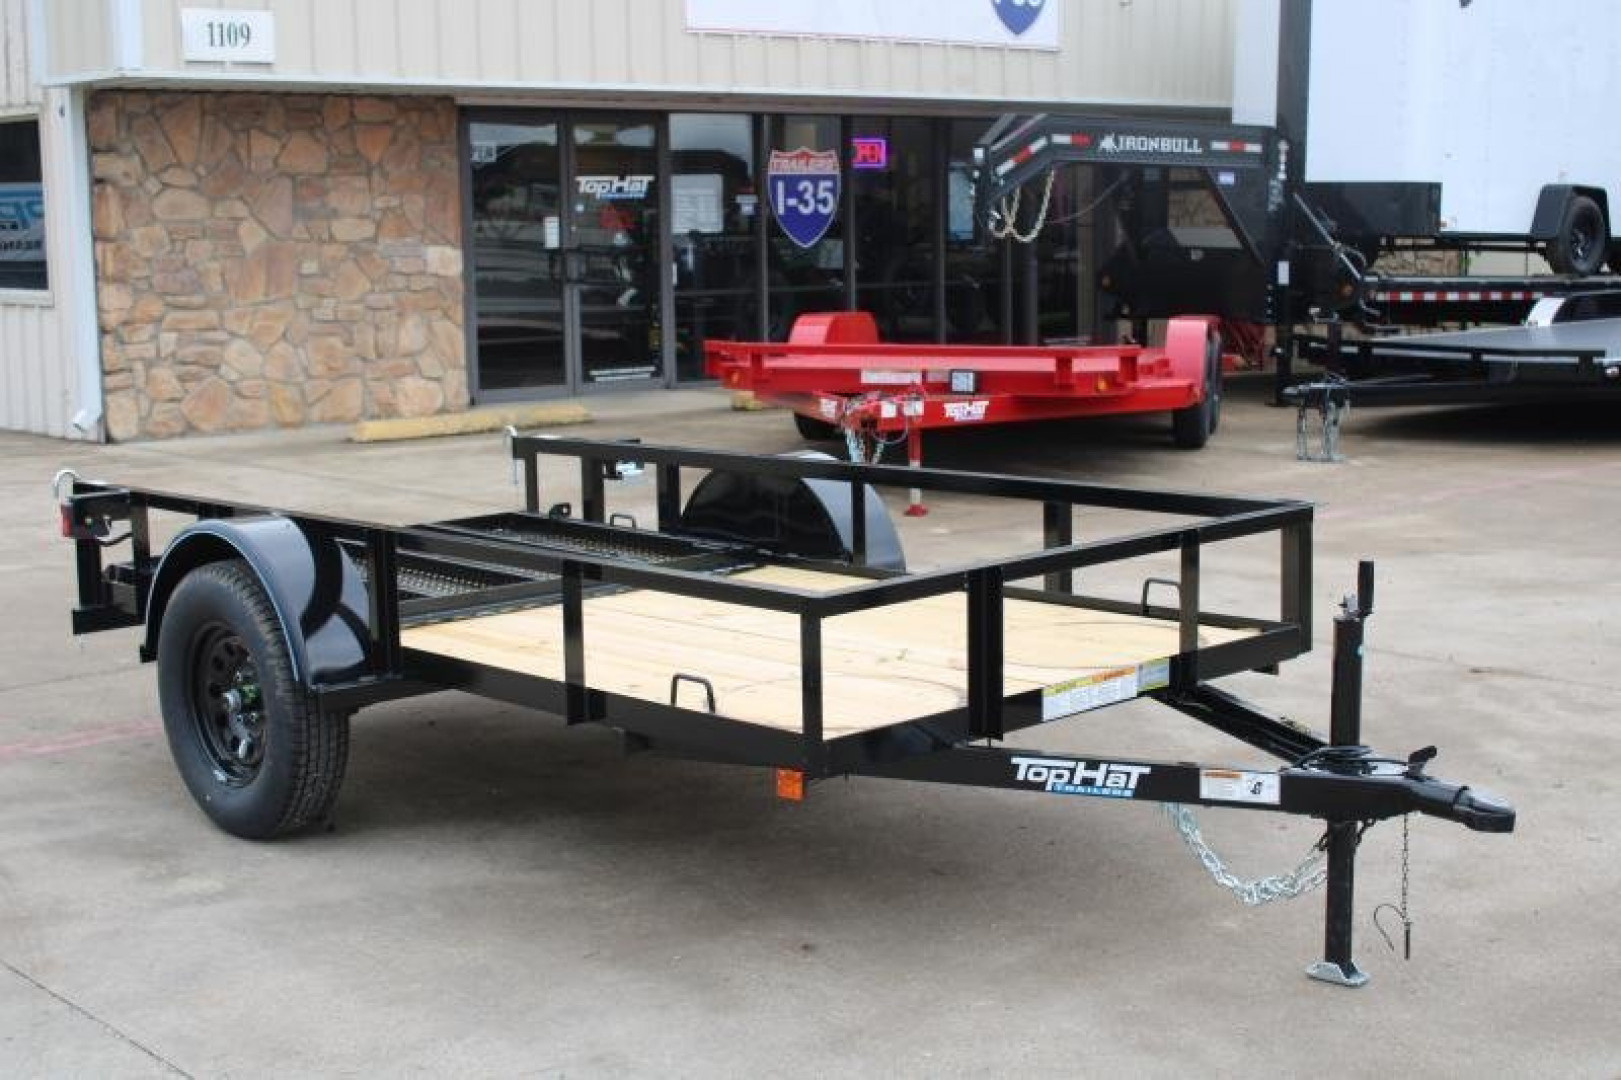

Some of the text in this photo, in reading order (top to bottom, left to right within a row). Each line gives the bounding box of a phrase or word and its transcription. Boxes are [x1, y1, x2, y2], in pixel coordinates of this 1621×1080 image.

[207, 21, 250, 48] 1109
[1117, 134, 1203, 153] IRONBULL
[777, 180, 834, 215] I-35
